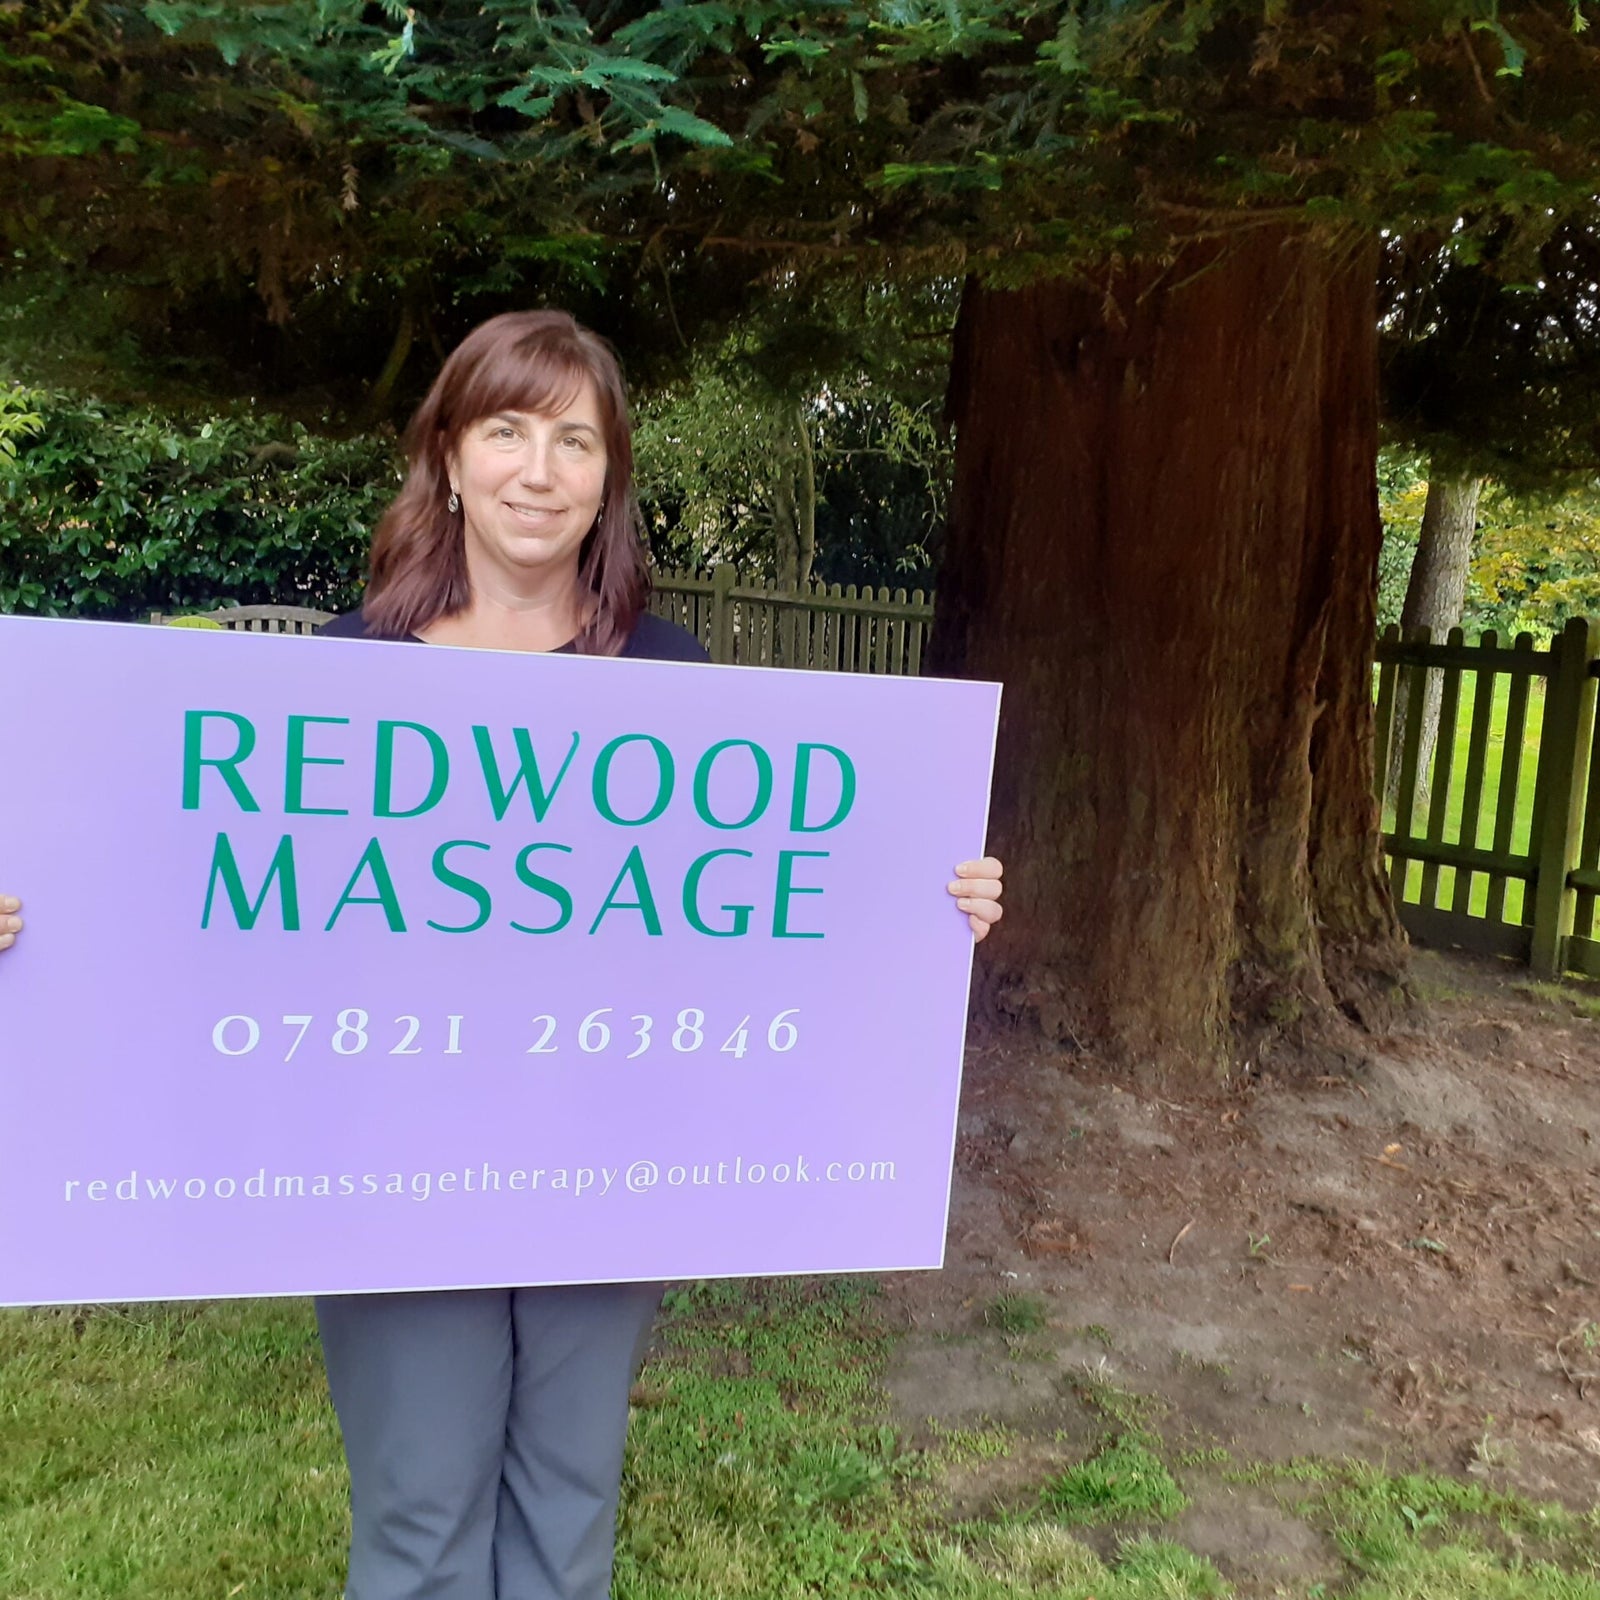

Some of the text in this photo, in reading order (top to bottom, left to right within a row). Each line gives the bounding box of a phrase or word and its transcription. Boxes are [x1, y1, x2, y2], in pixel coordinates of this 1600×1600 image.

[182, 709, 857, 834] REDWOOD
[200, 831, 831, 939] MASSAGE
[212, 1007, 801, 1062] 07821 263846
[65, 1154, 897, 1203] redwoodmassagetherapy@outlook.com
